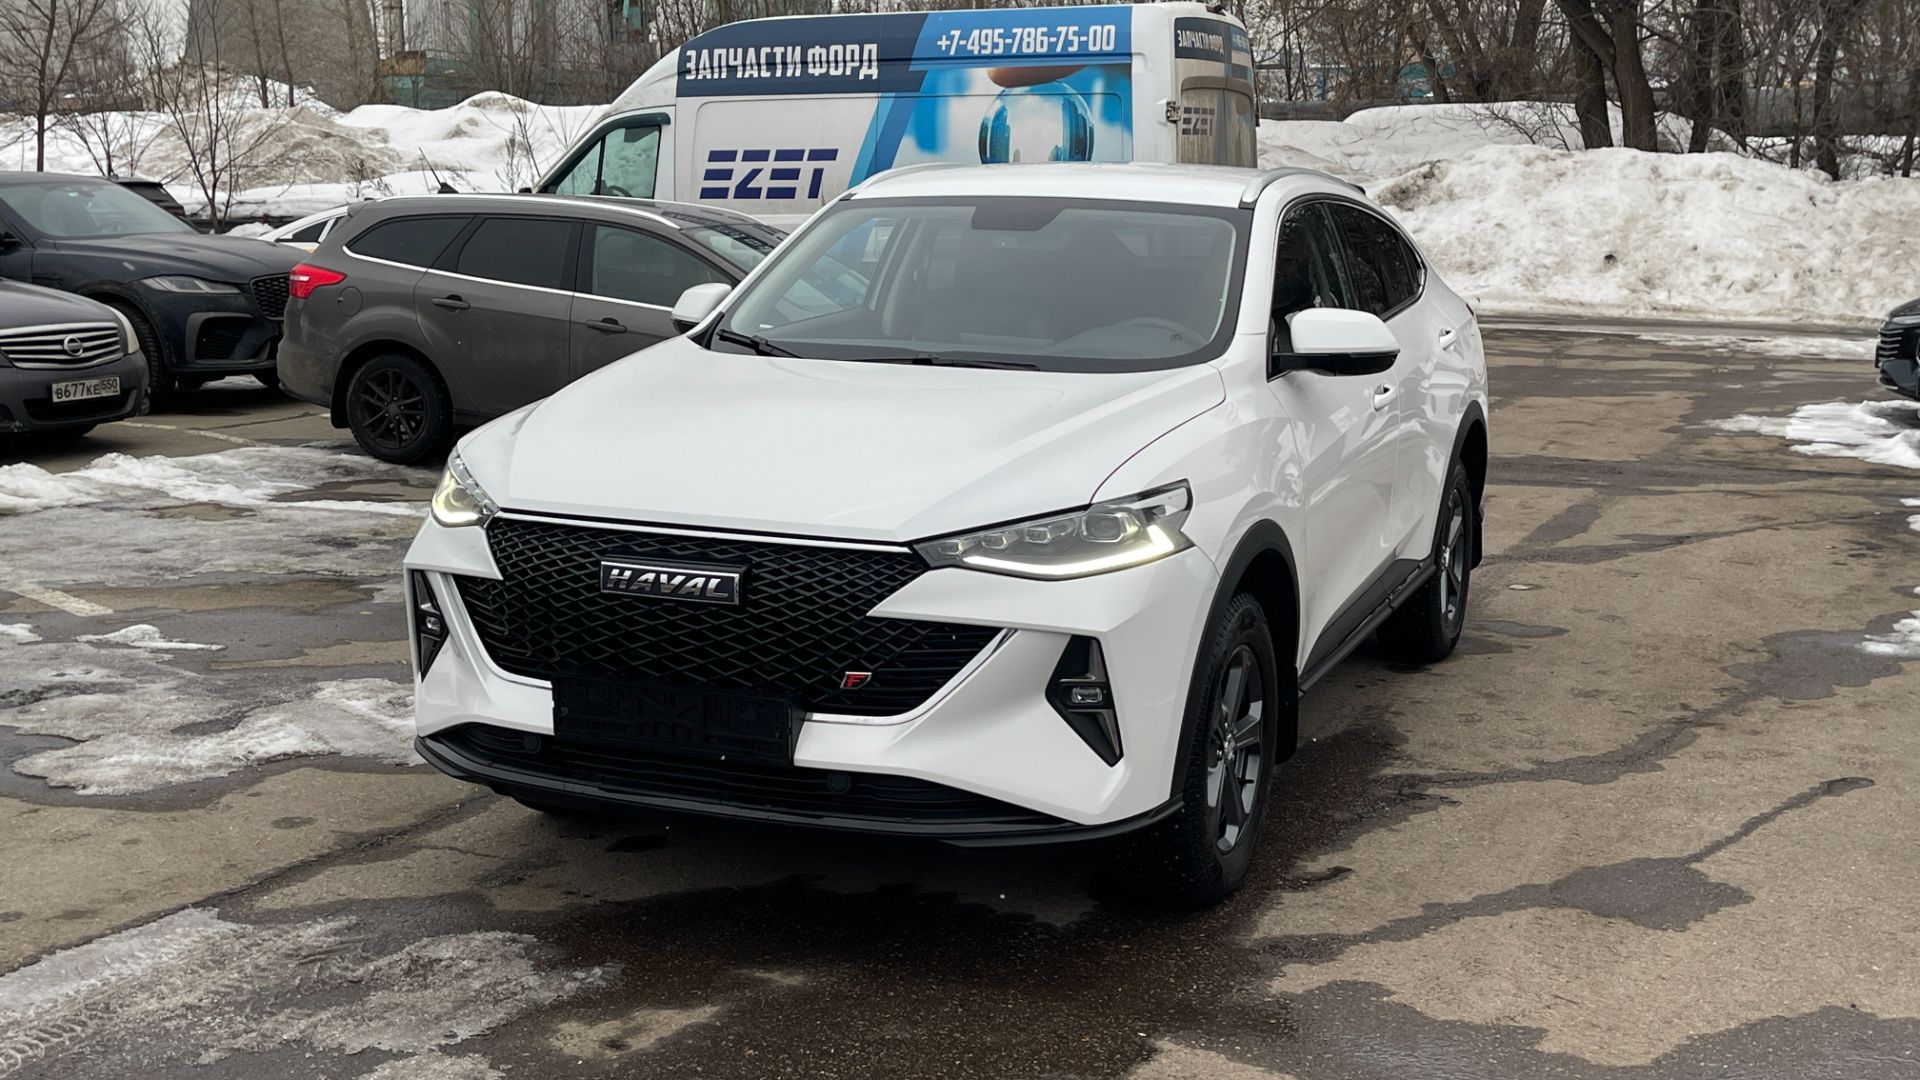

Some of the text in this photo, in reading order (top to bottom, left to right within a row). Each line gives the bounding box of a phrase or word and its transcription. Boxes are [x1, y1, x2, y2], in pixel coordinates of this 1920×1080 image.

[937, 25, 1116, 56] +7-495-786-75-00
[685, 43, 879, 80] ЗАПЧАСТИ ФОРД
[1182, 107, 1215, 136] EZET
[699, 148, 839, 199] EZET
[606, 568, 729, 598] HAVAL
